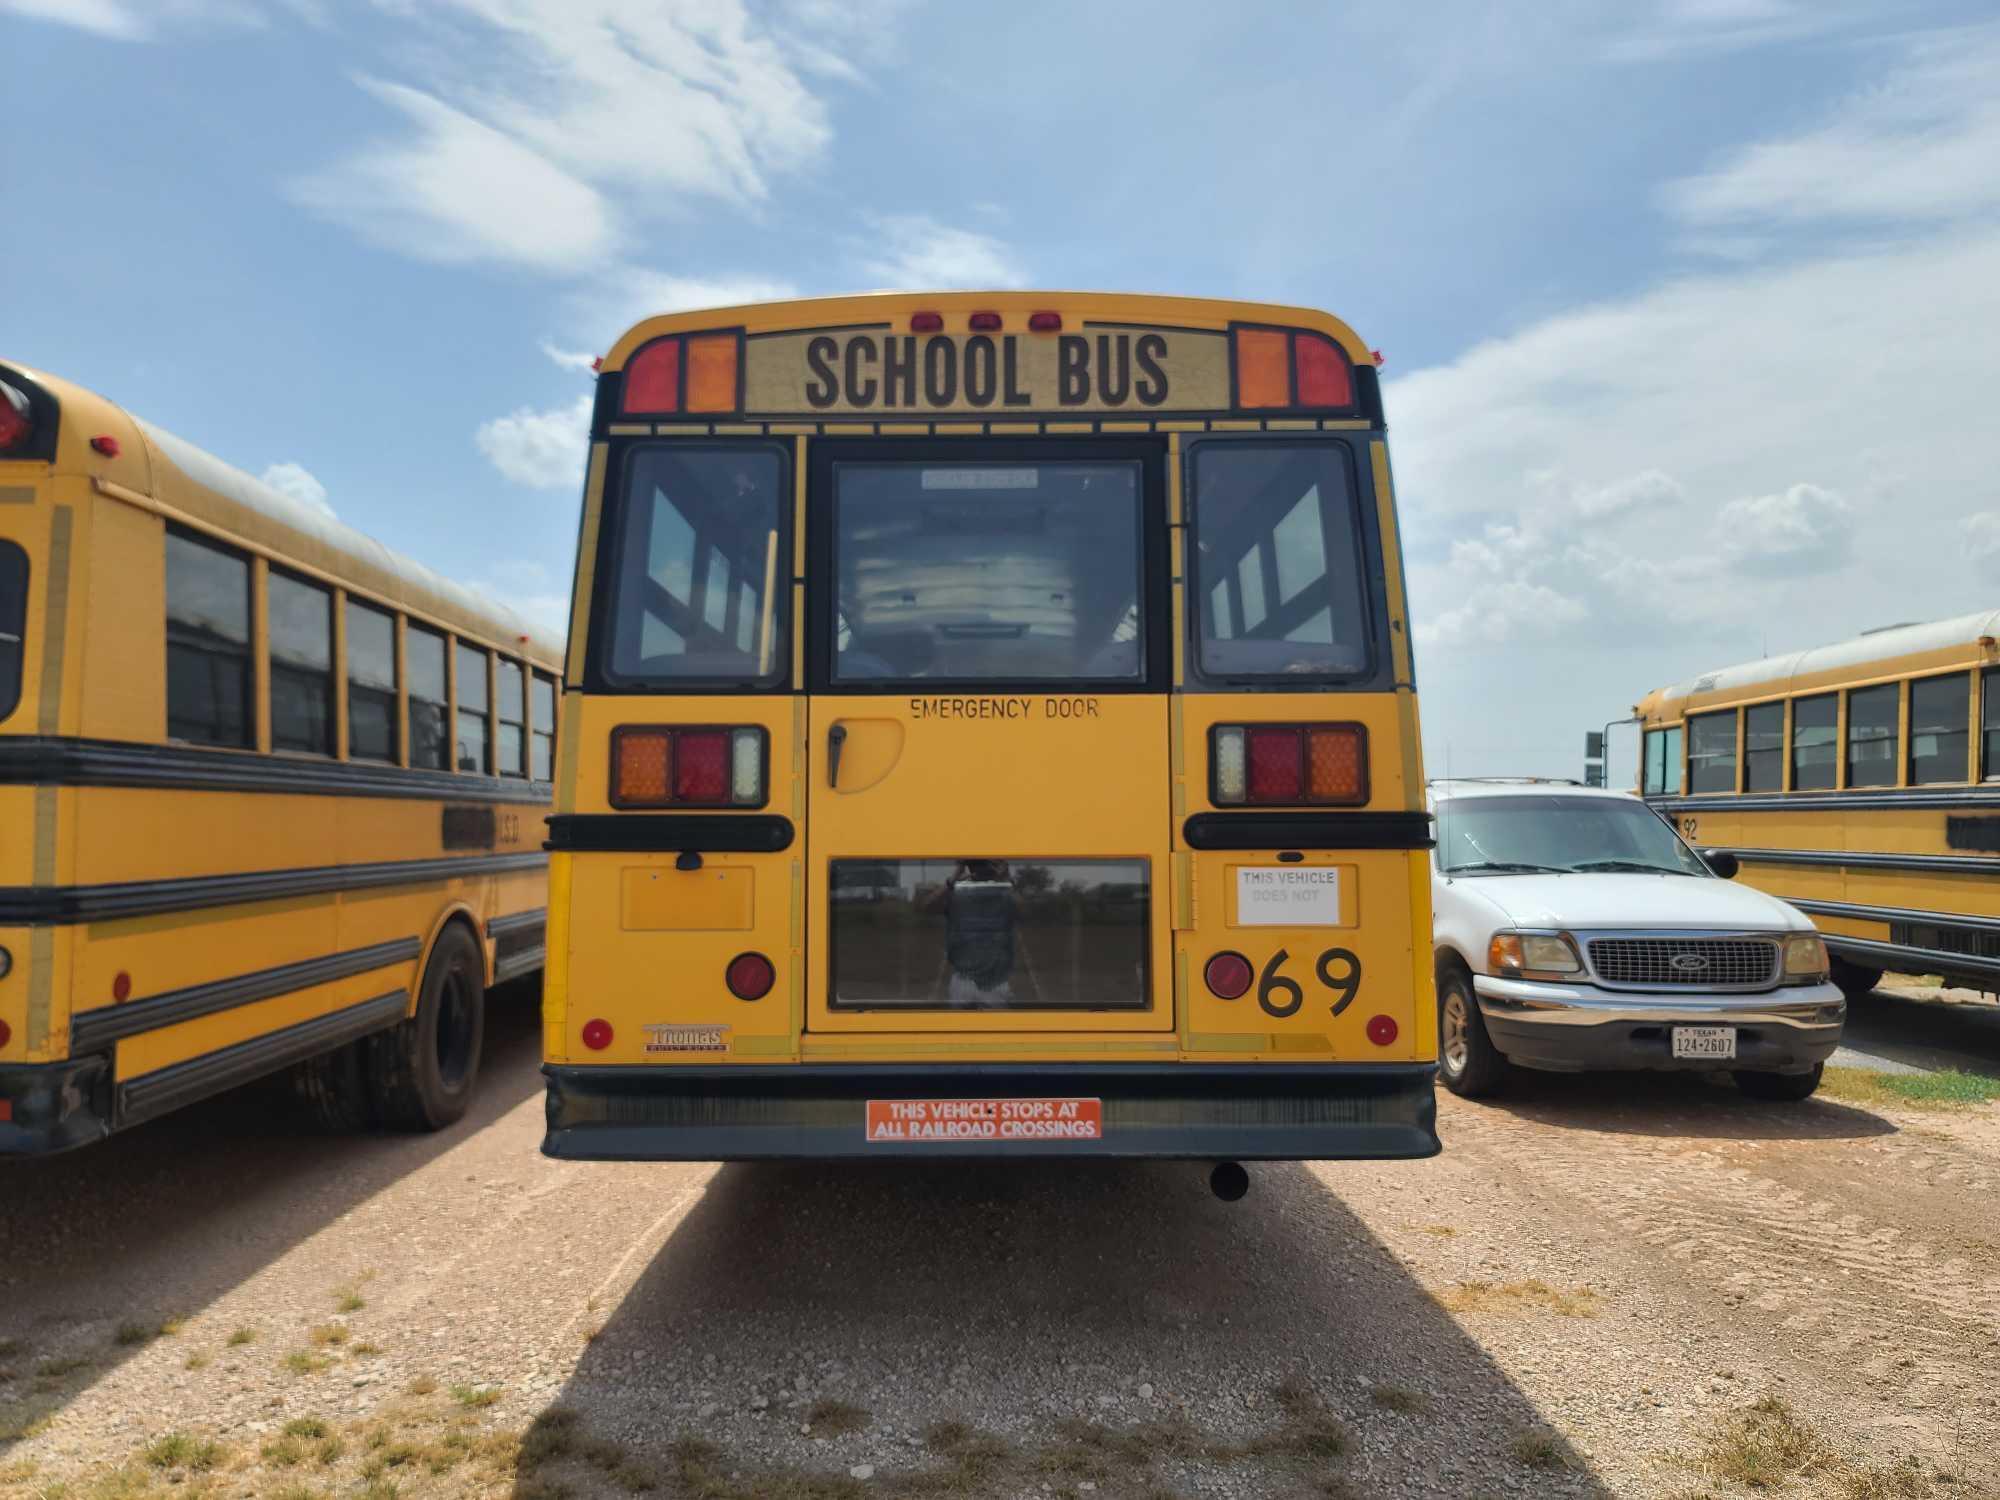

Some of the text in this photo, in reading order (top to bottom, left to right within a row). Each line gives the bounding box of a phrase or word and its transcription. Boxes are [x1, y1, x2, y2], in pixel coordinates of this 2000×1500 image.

[806, 334, 1168, 408] SCHOOL BUS
[911, 698, 1098, 719] EMERGENCY DOOR
[1684, 818, 1697, 840] 92
[1243, 872, 1334, 884] THIS VEHICLE
[1253, 889, 1319, 902] DOES NOT
[1258, 948, 1361, 1018] 69
[890, 1102, 1079, 1118] THIS VEHICLE STOPS AT
[874, 1120, 1095, 1137] ALL RAILROAD CROSSINGS
